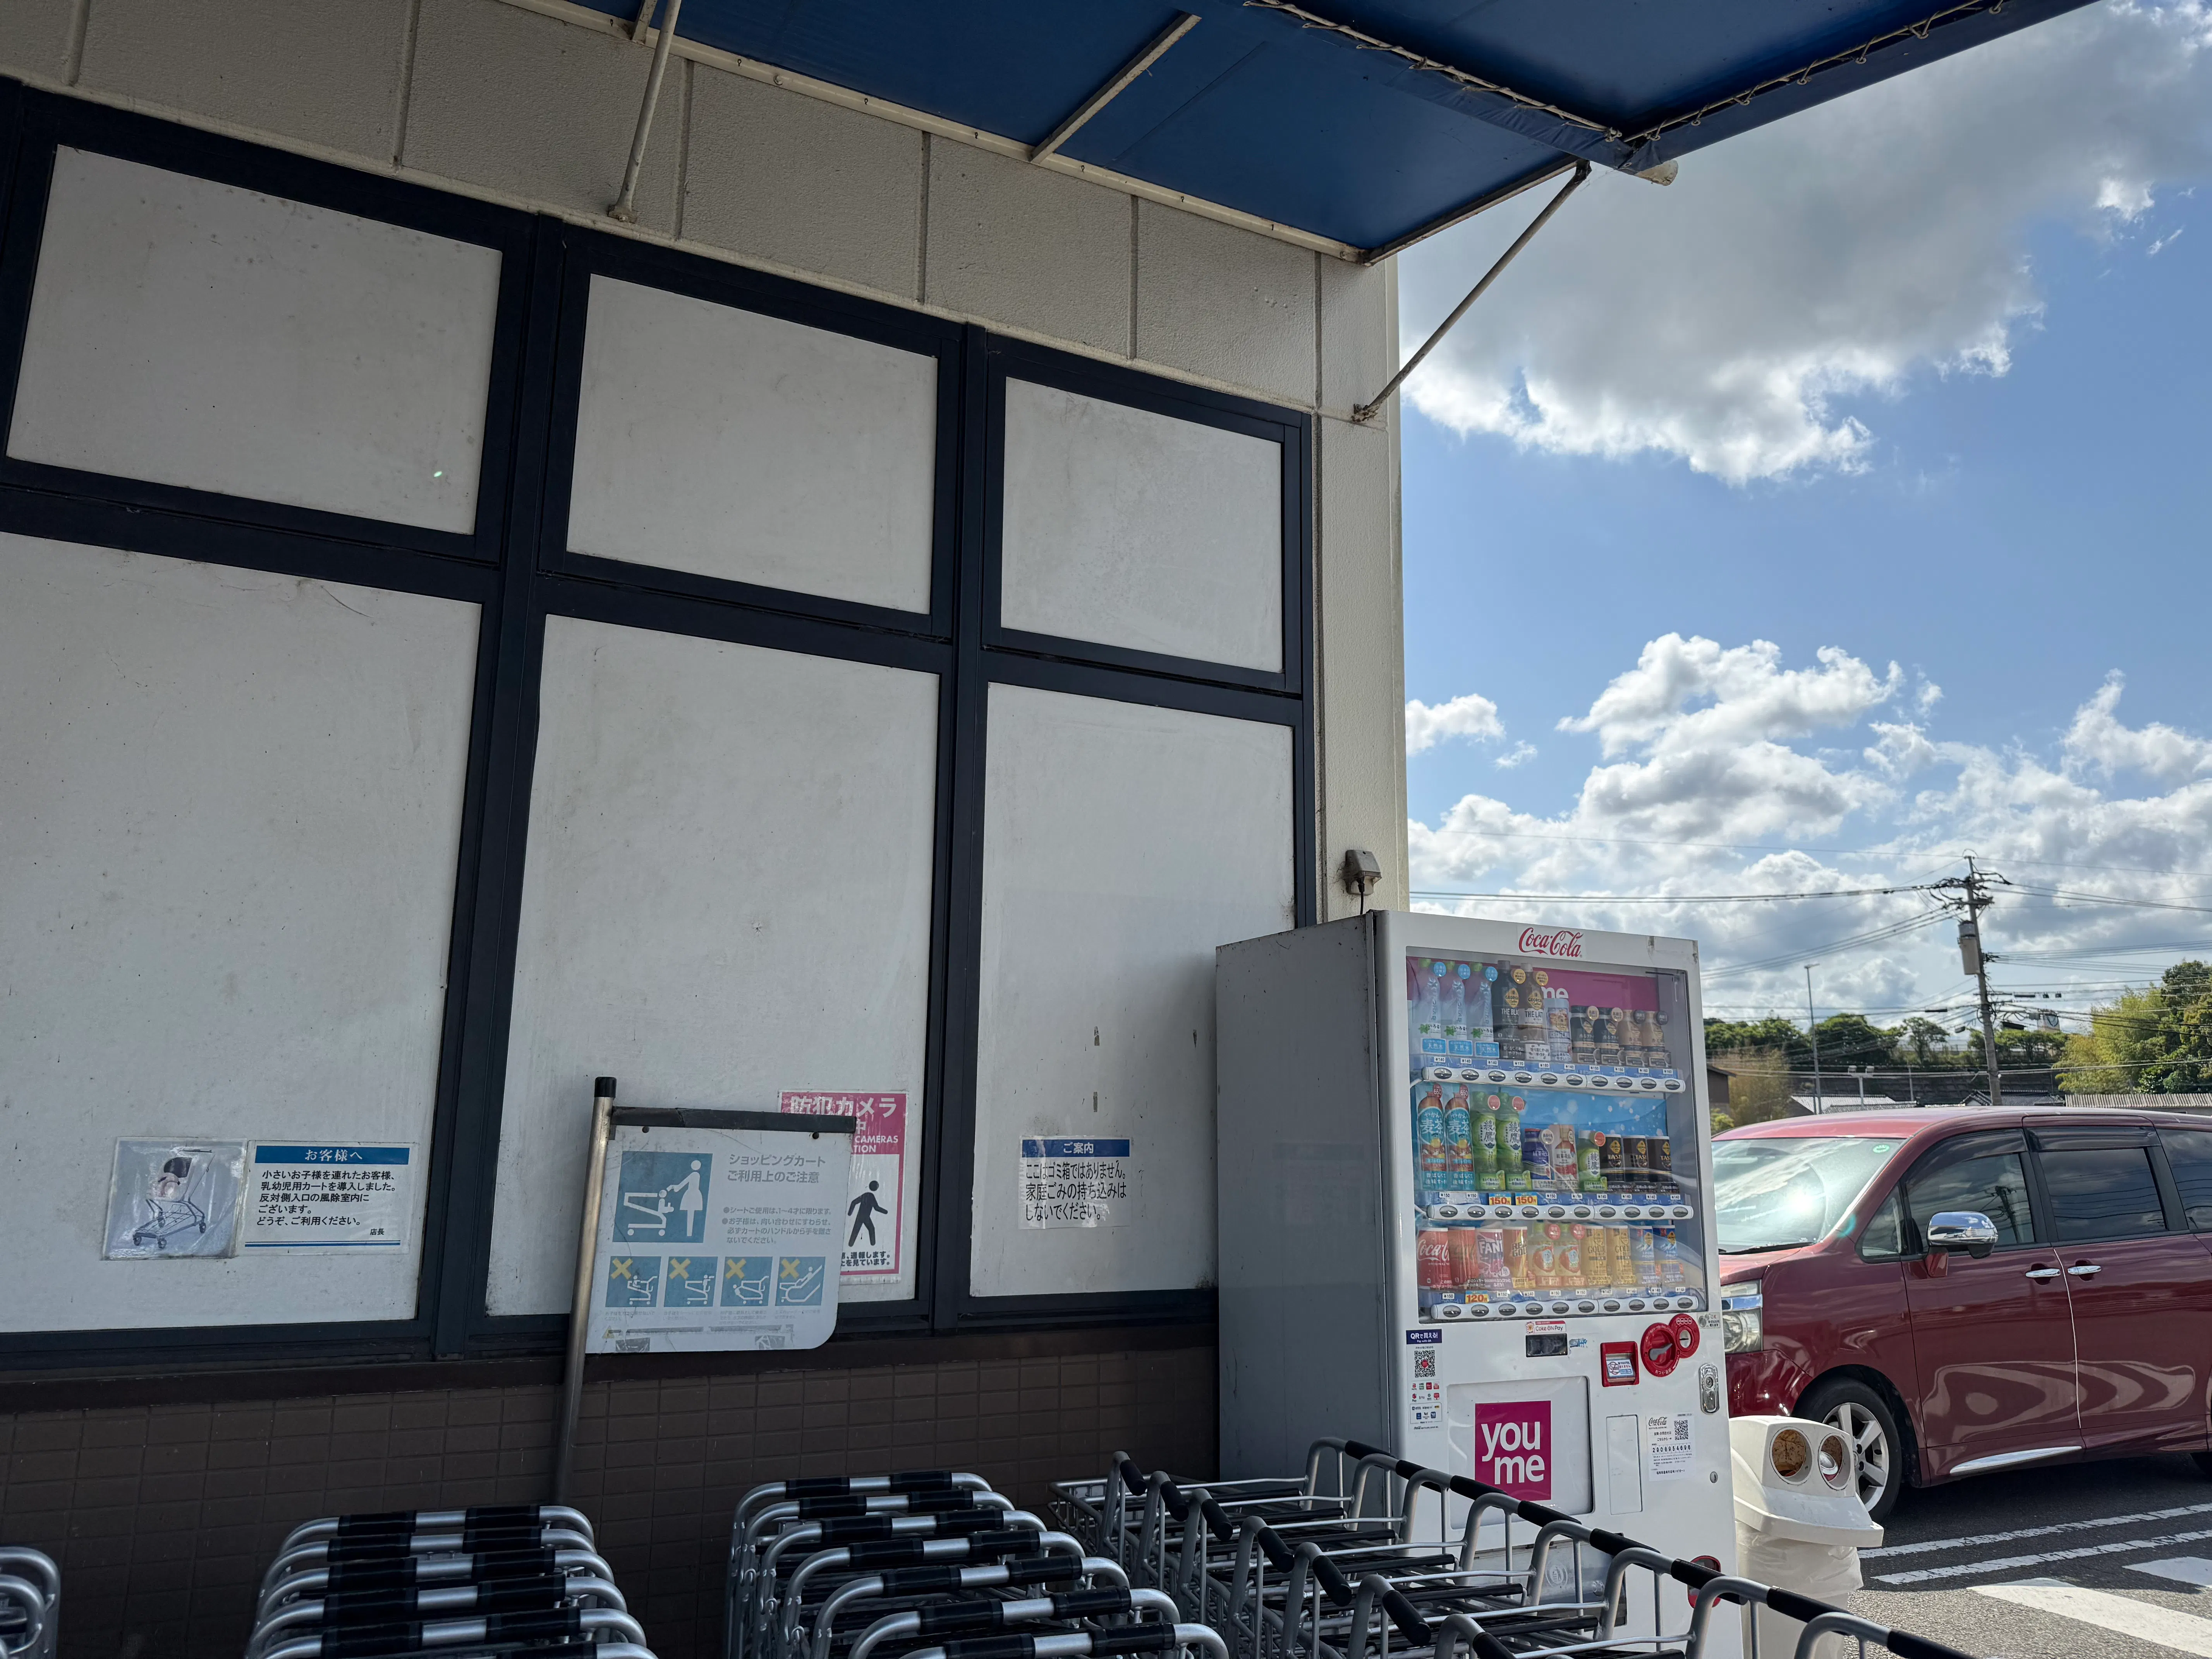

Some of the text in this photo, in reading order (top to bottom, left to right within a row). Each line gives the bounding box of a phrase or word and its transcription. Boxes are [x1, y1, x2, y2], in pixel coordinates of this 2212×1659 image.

[1518, 927, 1584, 957] Coca-Cola
[790, 1096, 897, 1118] 防犯カメラ
[1420, 1119, 1443, 1134] 麦茶
[1448, 1120, 1470, 1135] 麦茶
[855, 1135, 898, 1144] CAMERAS
[305, 1149, 362, 1161] お客様へ
[1063, 1142, 1094, 1154] ご案内
[730, 1153, 826, 1167] ショッピングカート
[262, 1170, 395, 1180] 小さいお子様を連れたお客様、
[728, 1170, 819, 1183] ご利用上のご注意
[1026, 1160, 1126, 1180] ここはゴミ箱ではありません。
[261, 1182, 395, 1191] 乳幼児用カートを導入しました。
[1026, 1182, 1127, 1201] 家庭ごみの持ち込みは
[259, 1193, 369, 1202] 反対側入口の風除室内に
[258, 1204, 311, 1214] ございます。
[1026, 1202, 1100, 1221] しないでください。
[256, 1216, 361, 1226] どうぞ、ご利用ください。
[1481, 1421, 1540, 1462] you
[1494, 1455, 1545, 1485] me
